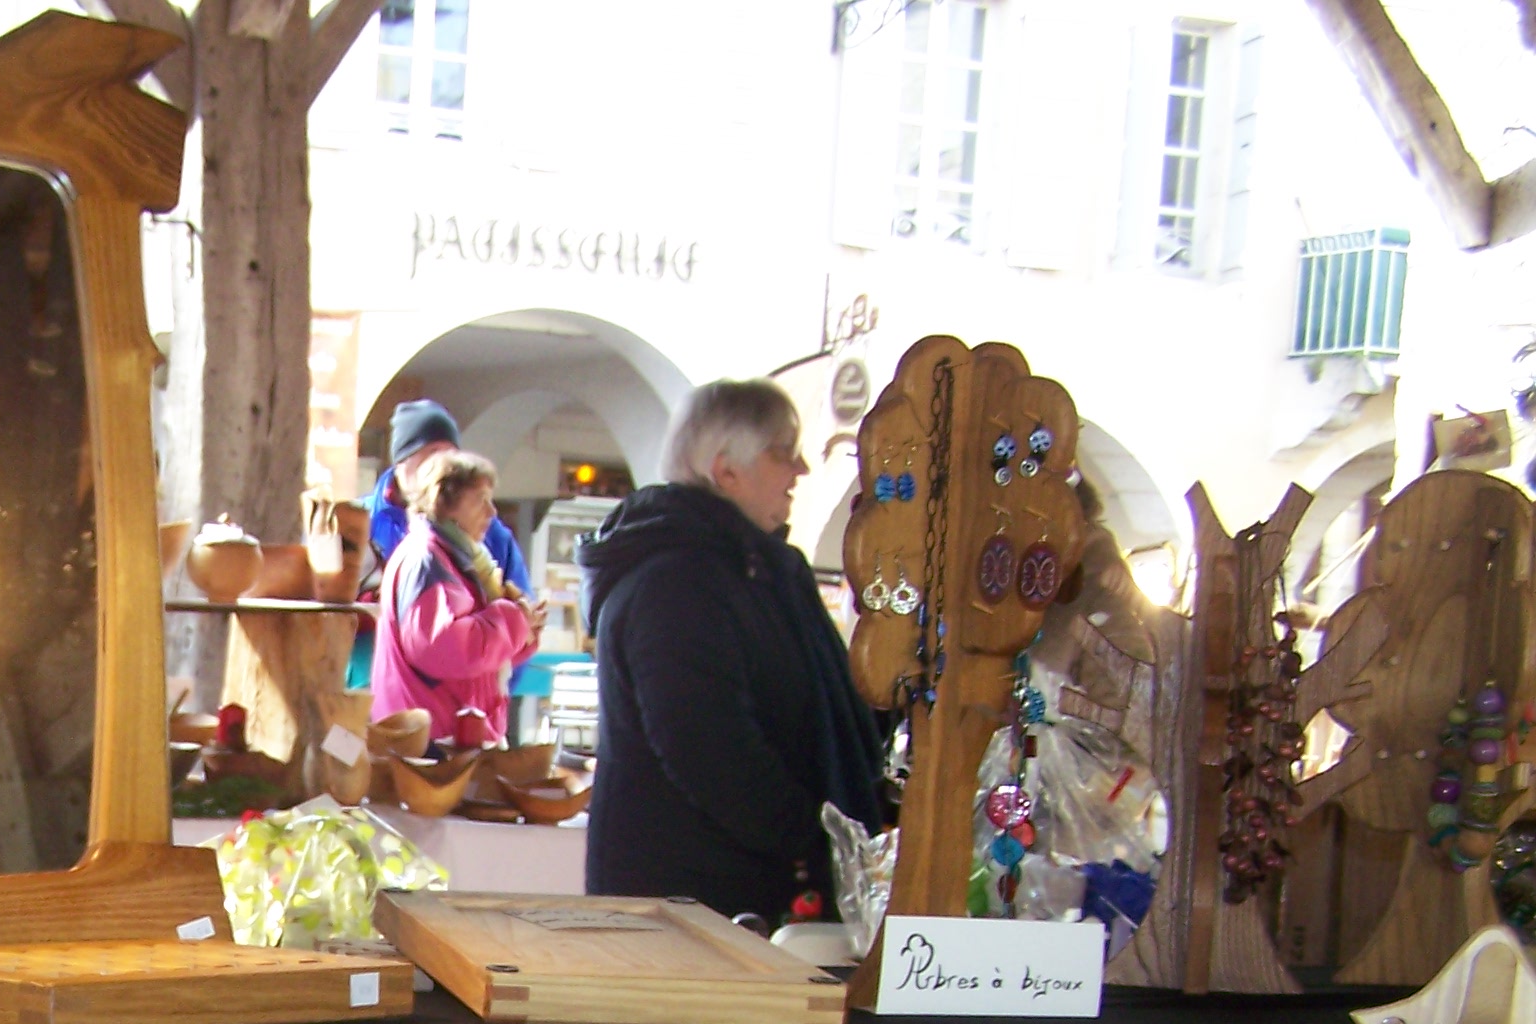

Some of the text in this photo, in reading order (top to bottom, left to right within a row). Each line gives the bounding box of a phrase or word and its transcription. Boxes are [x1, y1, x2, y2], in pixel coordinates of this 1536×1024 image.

[896, 933, 1084, 999] Arbres à bijoux
